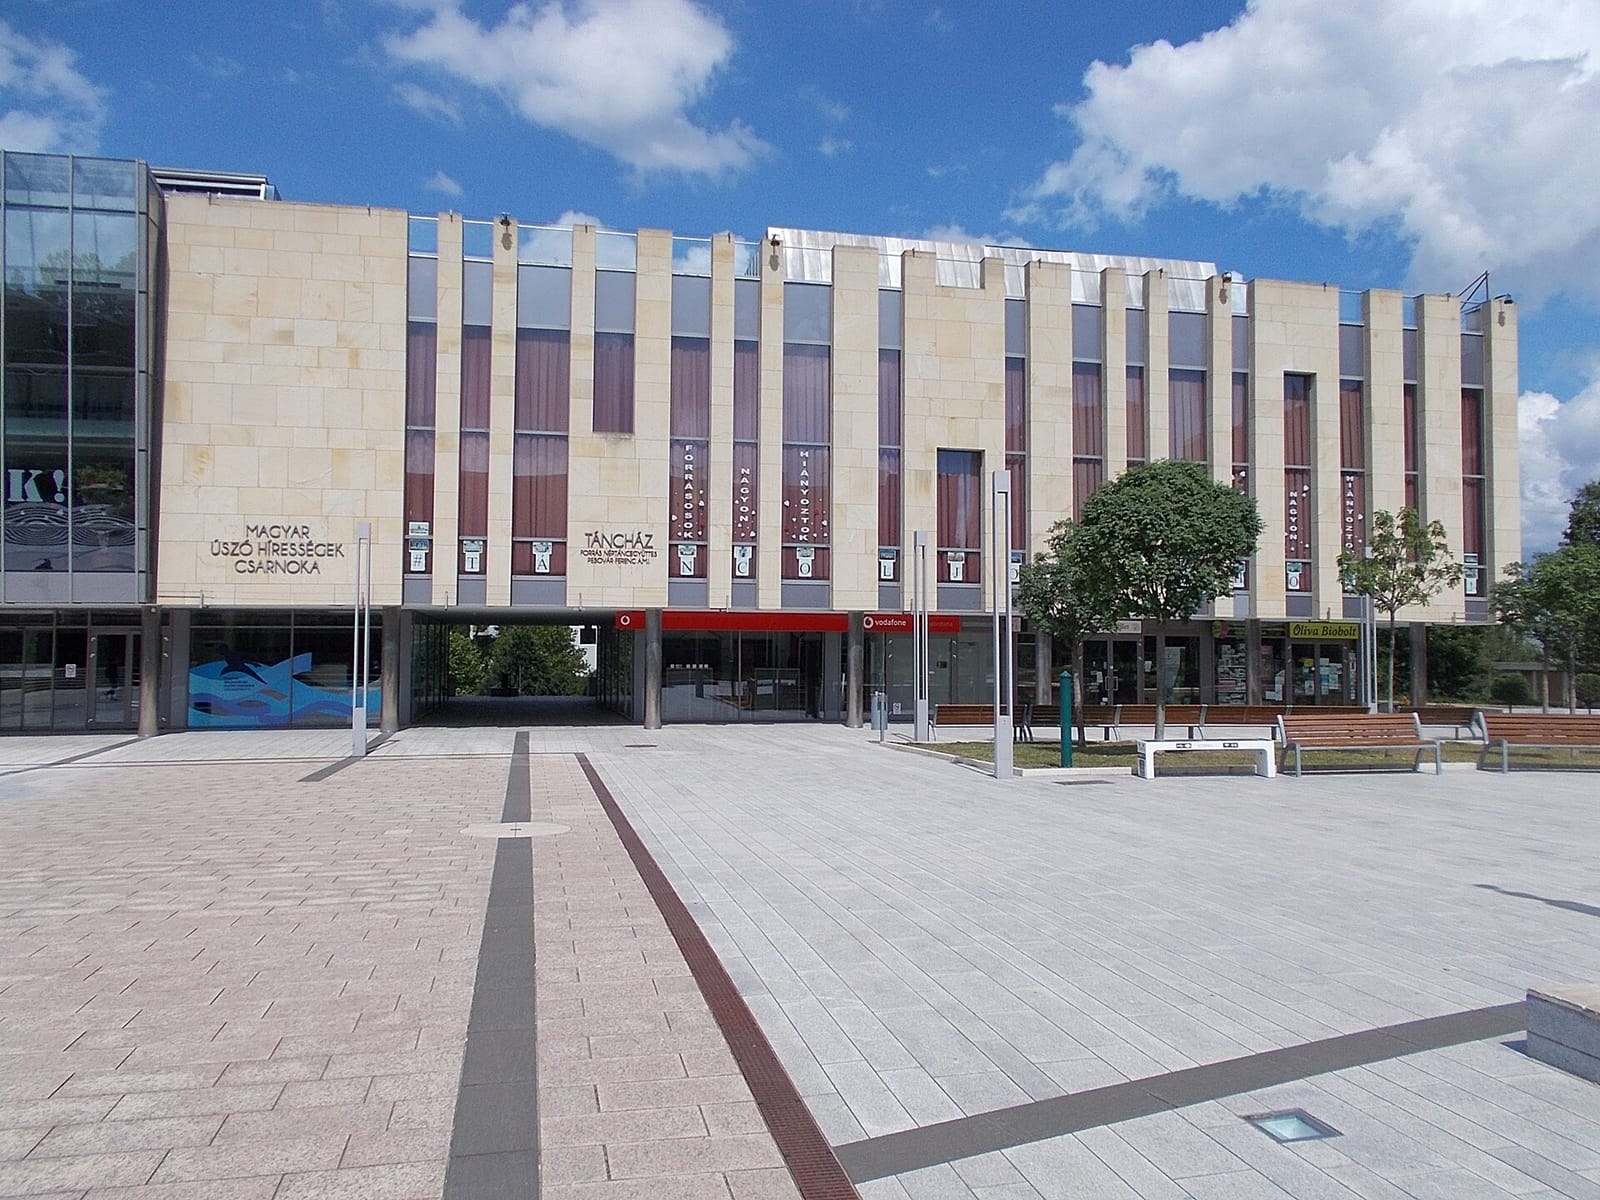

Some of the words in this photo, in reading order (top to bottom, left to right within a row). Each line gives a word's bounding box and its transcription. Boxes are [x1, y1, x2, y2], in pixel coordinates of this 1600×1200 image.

[7, 468, 65, 503] K!
[739, 468, 750, 522] NAGYON
[1289, 491, 1298, 541] NAGYON
[245, 524, 311, 539] MAGYAR
[584, 530, 654, 549] TÁNCHÁZ
[210, 539, 254, 556] ÚSZÓ
[257, 540, 345, 558] HÍRESSÉGEK
[234, 560, 321, 574] CSARNOKA
[682, 560, 694, 573] N
[874, 618, 907, 627] vodafone
[1292, 623, 1319, 637] Oliva
[1321, 625, 1357, 637] Biobolt
